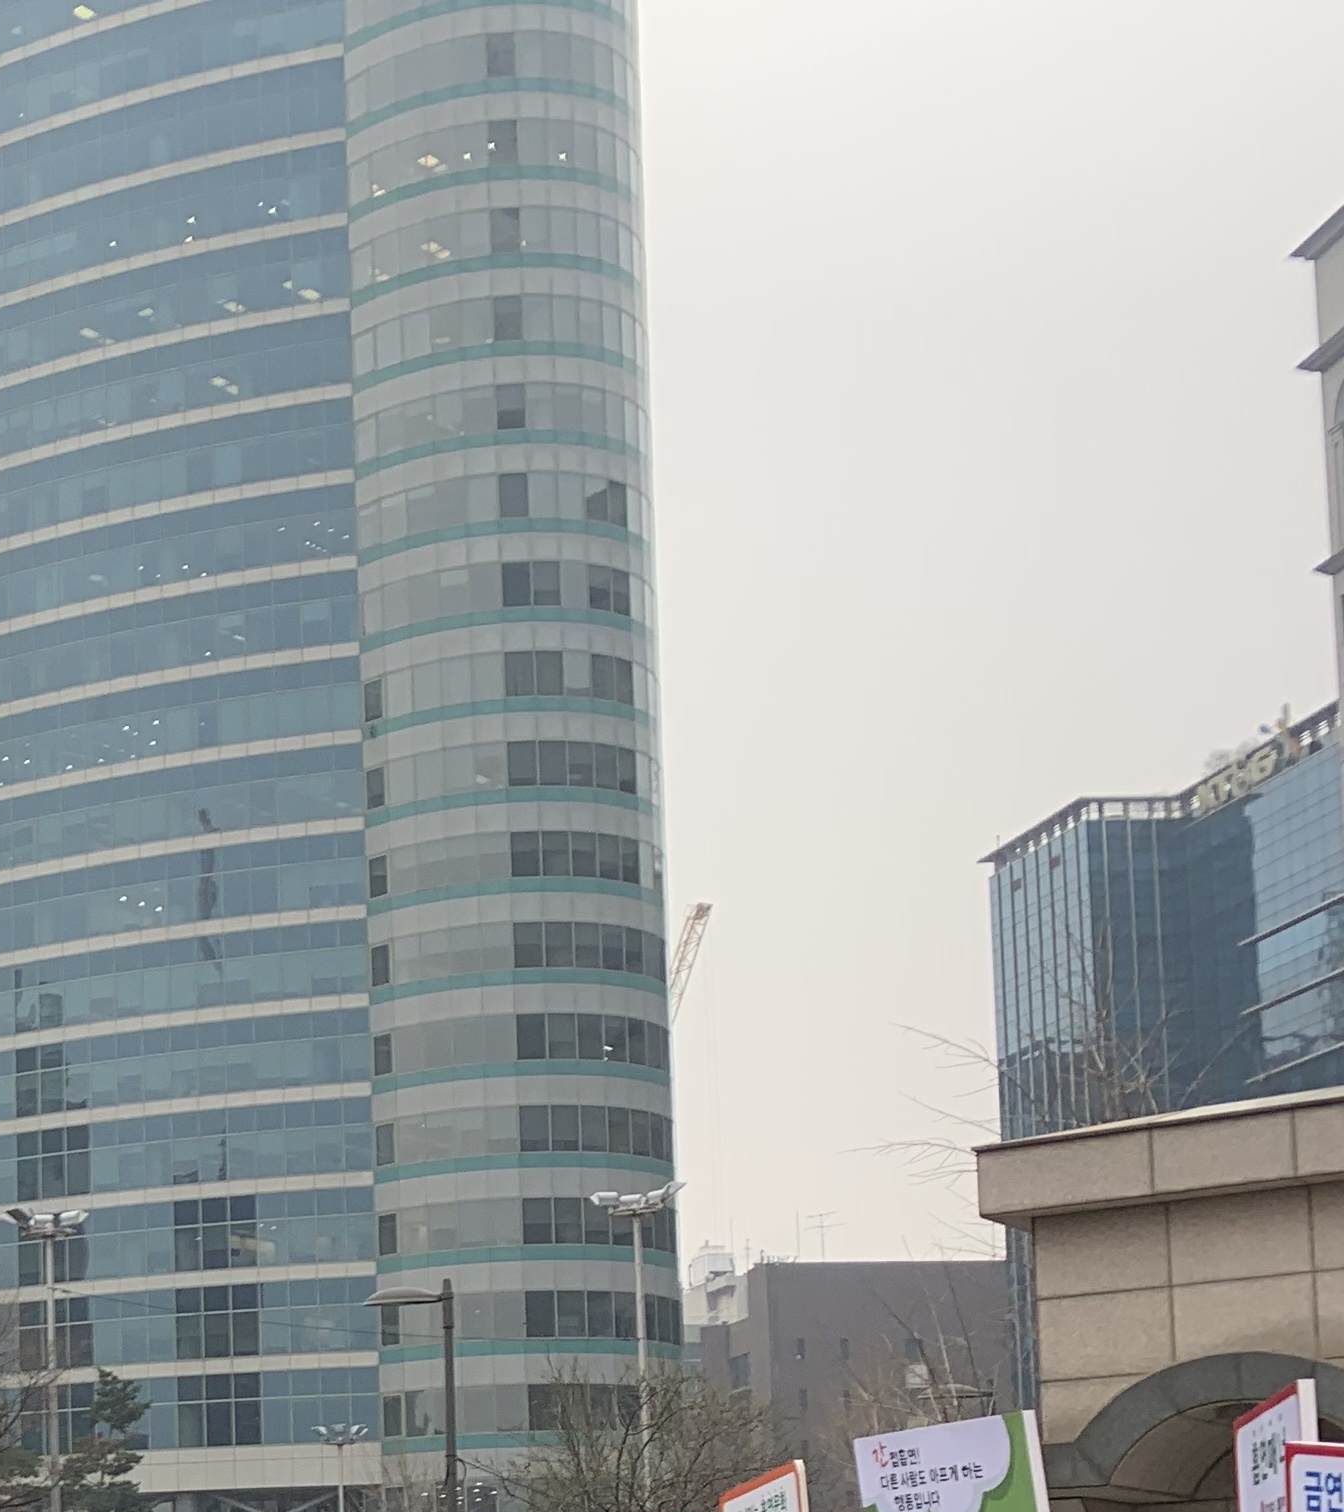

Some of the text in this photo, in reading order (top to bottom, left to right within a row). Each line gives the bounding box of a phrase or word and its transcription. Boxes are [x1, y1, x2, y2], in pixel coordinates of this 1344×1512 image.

[872, 1441, 921, 1469] 간접흡연!
[880, 1462, 984, 1491] 다른 사람도 아프게 하는
[894, 1490, 941, 1512] 행동입니다
